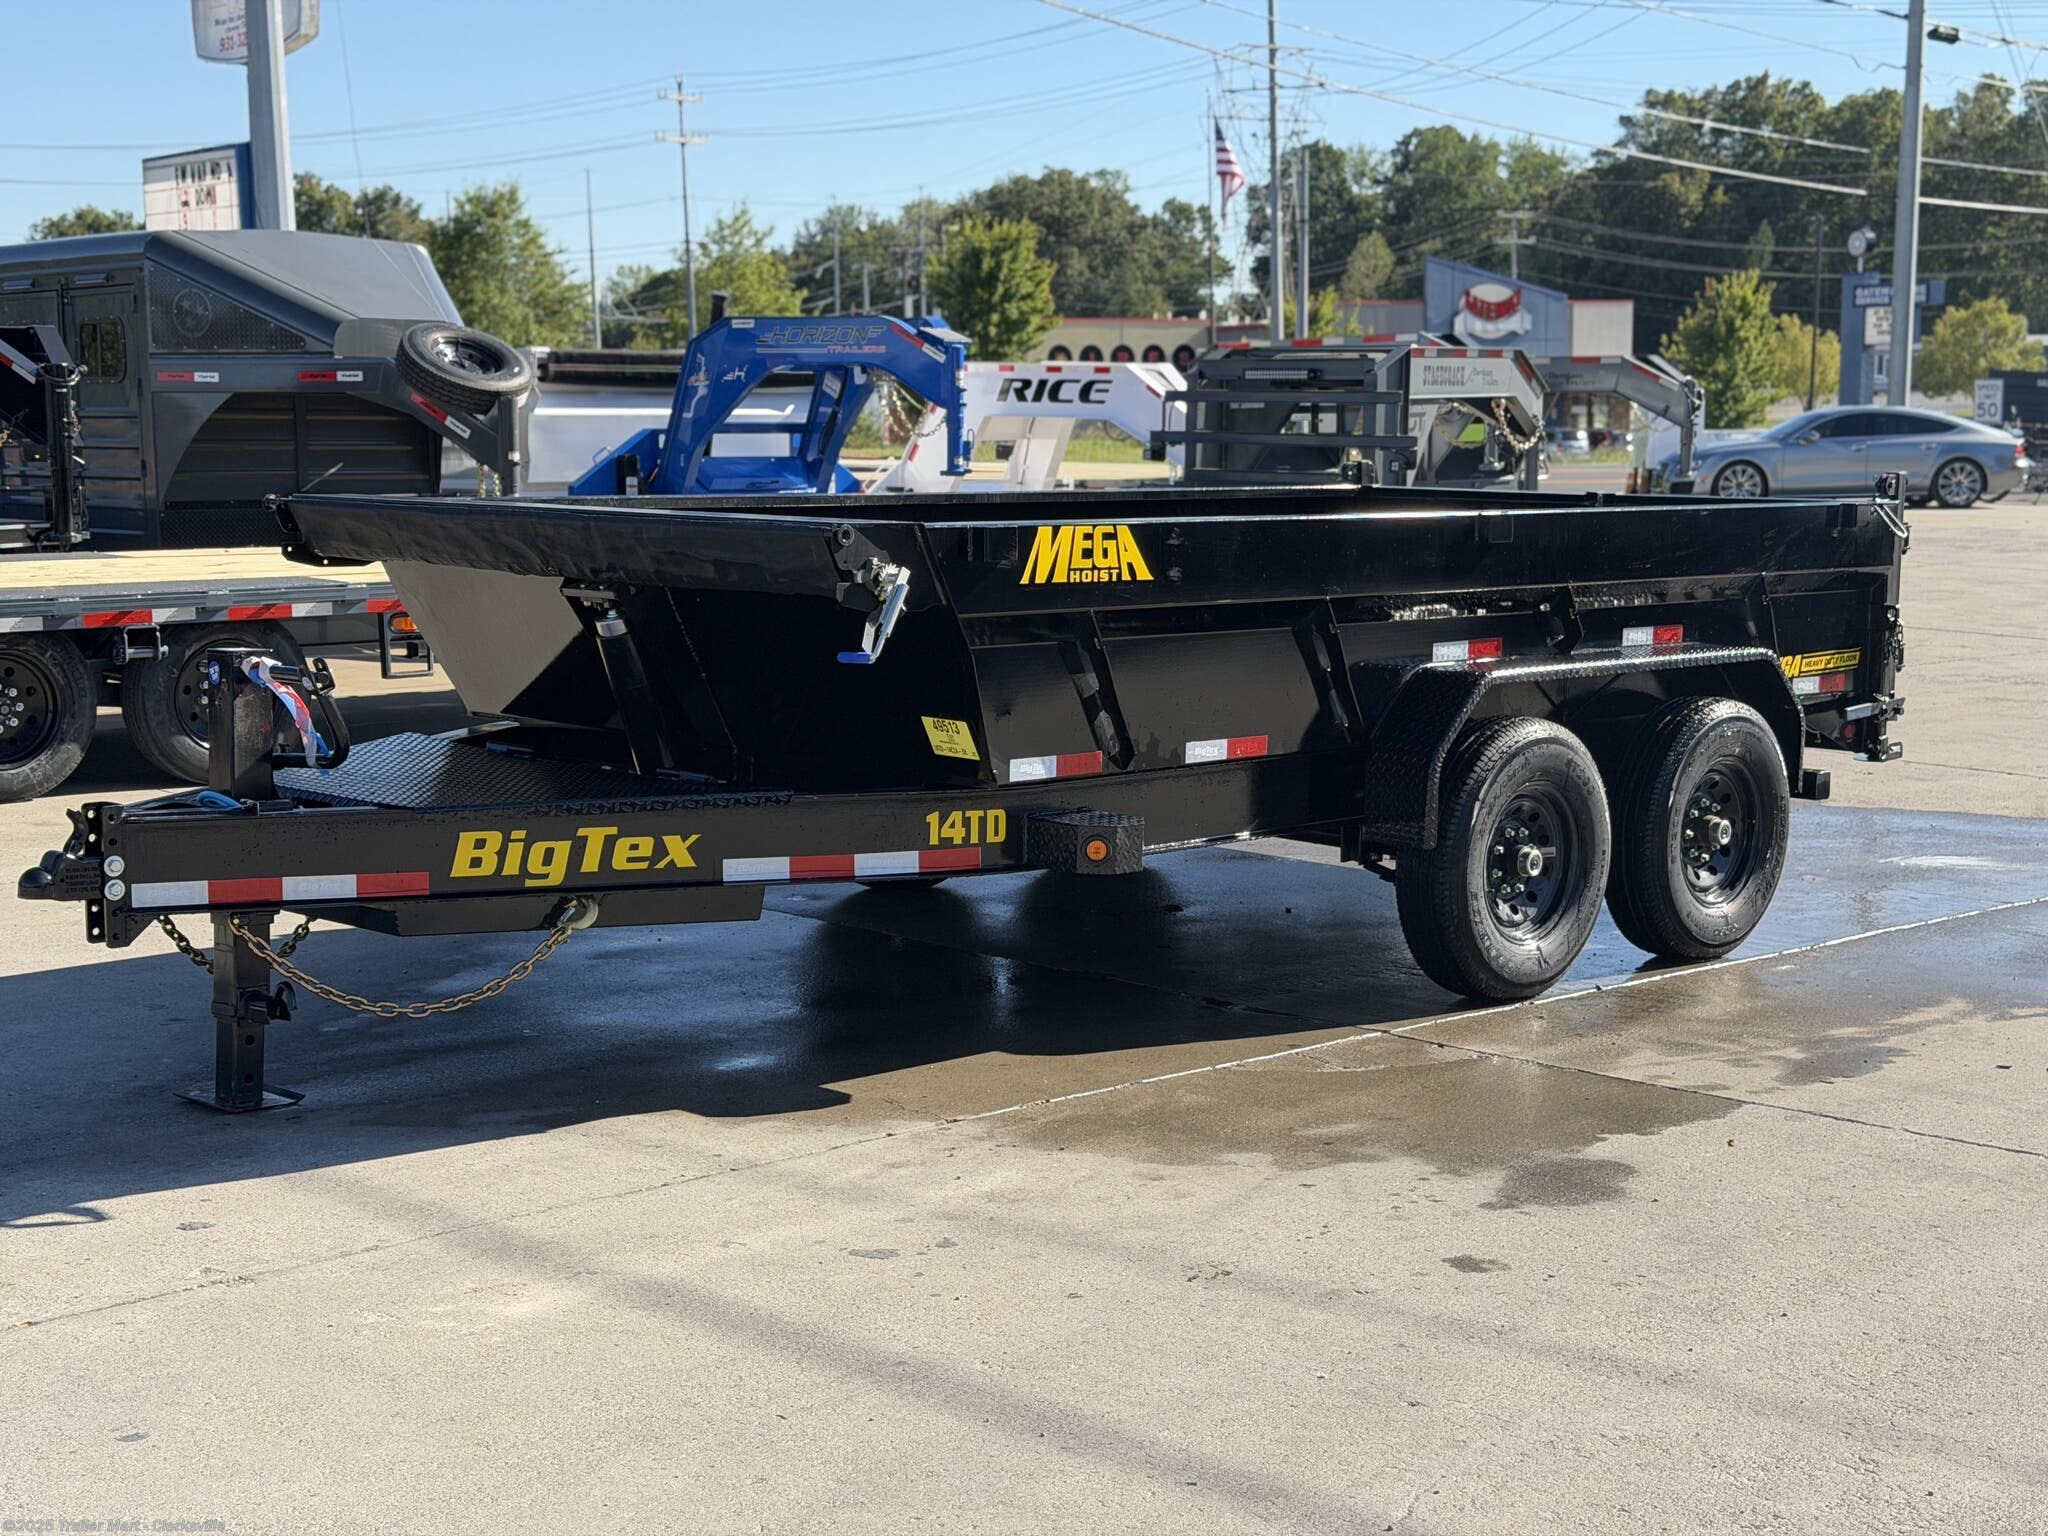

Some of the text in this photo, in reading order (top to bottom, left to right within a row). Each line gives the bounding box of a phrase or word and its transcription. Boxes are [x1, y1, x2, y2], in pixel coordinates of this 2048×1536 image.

[770, 326, 868, 345] HORIZON
[827, 345, 887, 354] TRAILERS
[996, 378, 1114, 404] RICE
[1976, 402, 1999, 418] 50
[1019, 525, 1154, 584] MEGA
[1069, 569, 1120, 583] HOIST
[1780, 654, 1802, 677] GA
[1804, 659, 1823, 668] HEAVY
[932, 719, 961, 735] 49513
[926, 808, 1007, 846] 14TD
[450, 826, 702, 887] BigTex
